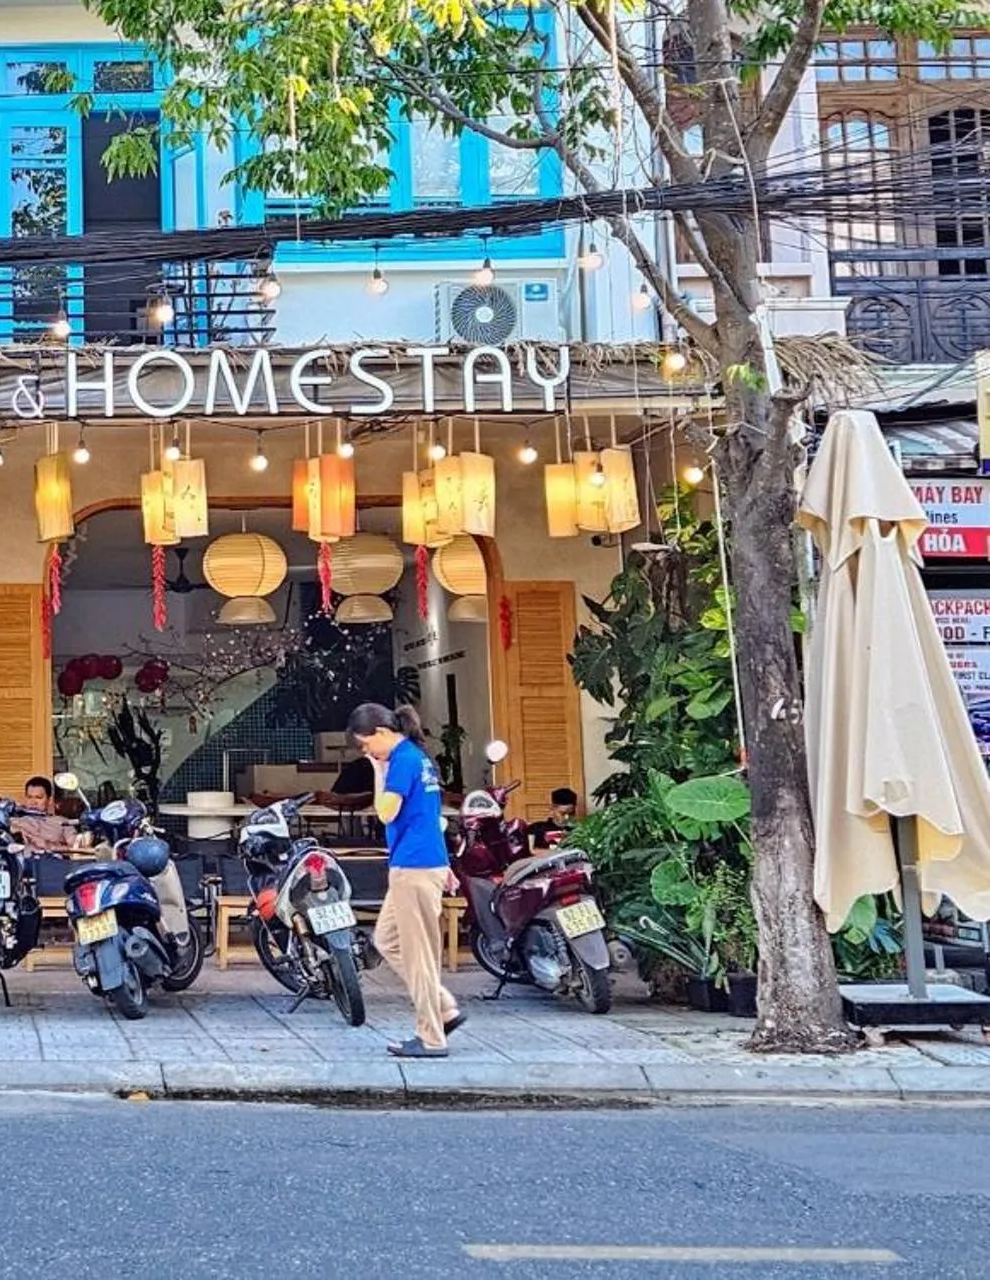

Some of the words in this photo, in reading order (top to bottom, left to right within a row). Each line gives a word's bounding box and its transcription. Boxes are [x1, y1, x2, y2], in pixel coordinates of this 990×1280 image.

[12, 375, 44, 418] &
[67, 346, 570, 417] HOMESTAY
[951, 486, 983, 503] BAY
[926, 510, 958, 524] ines
[937, 626, 965, 640] OD
